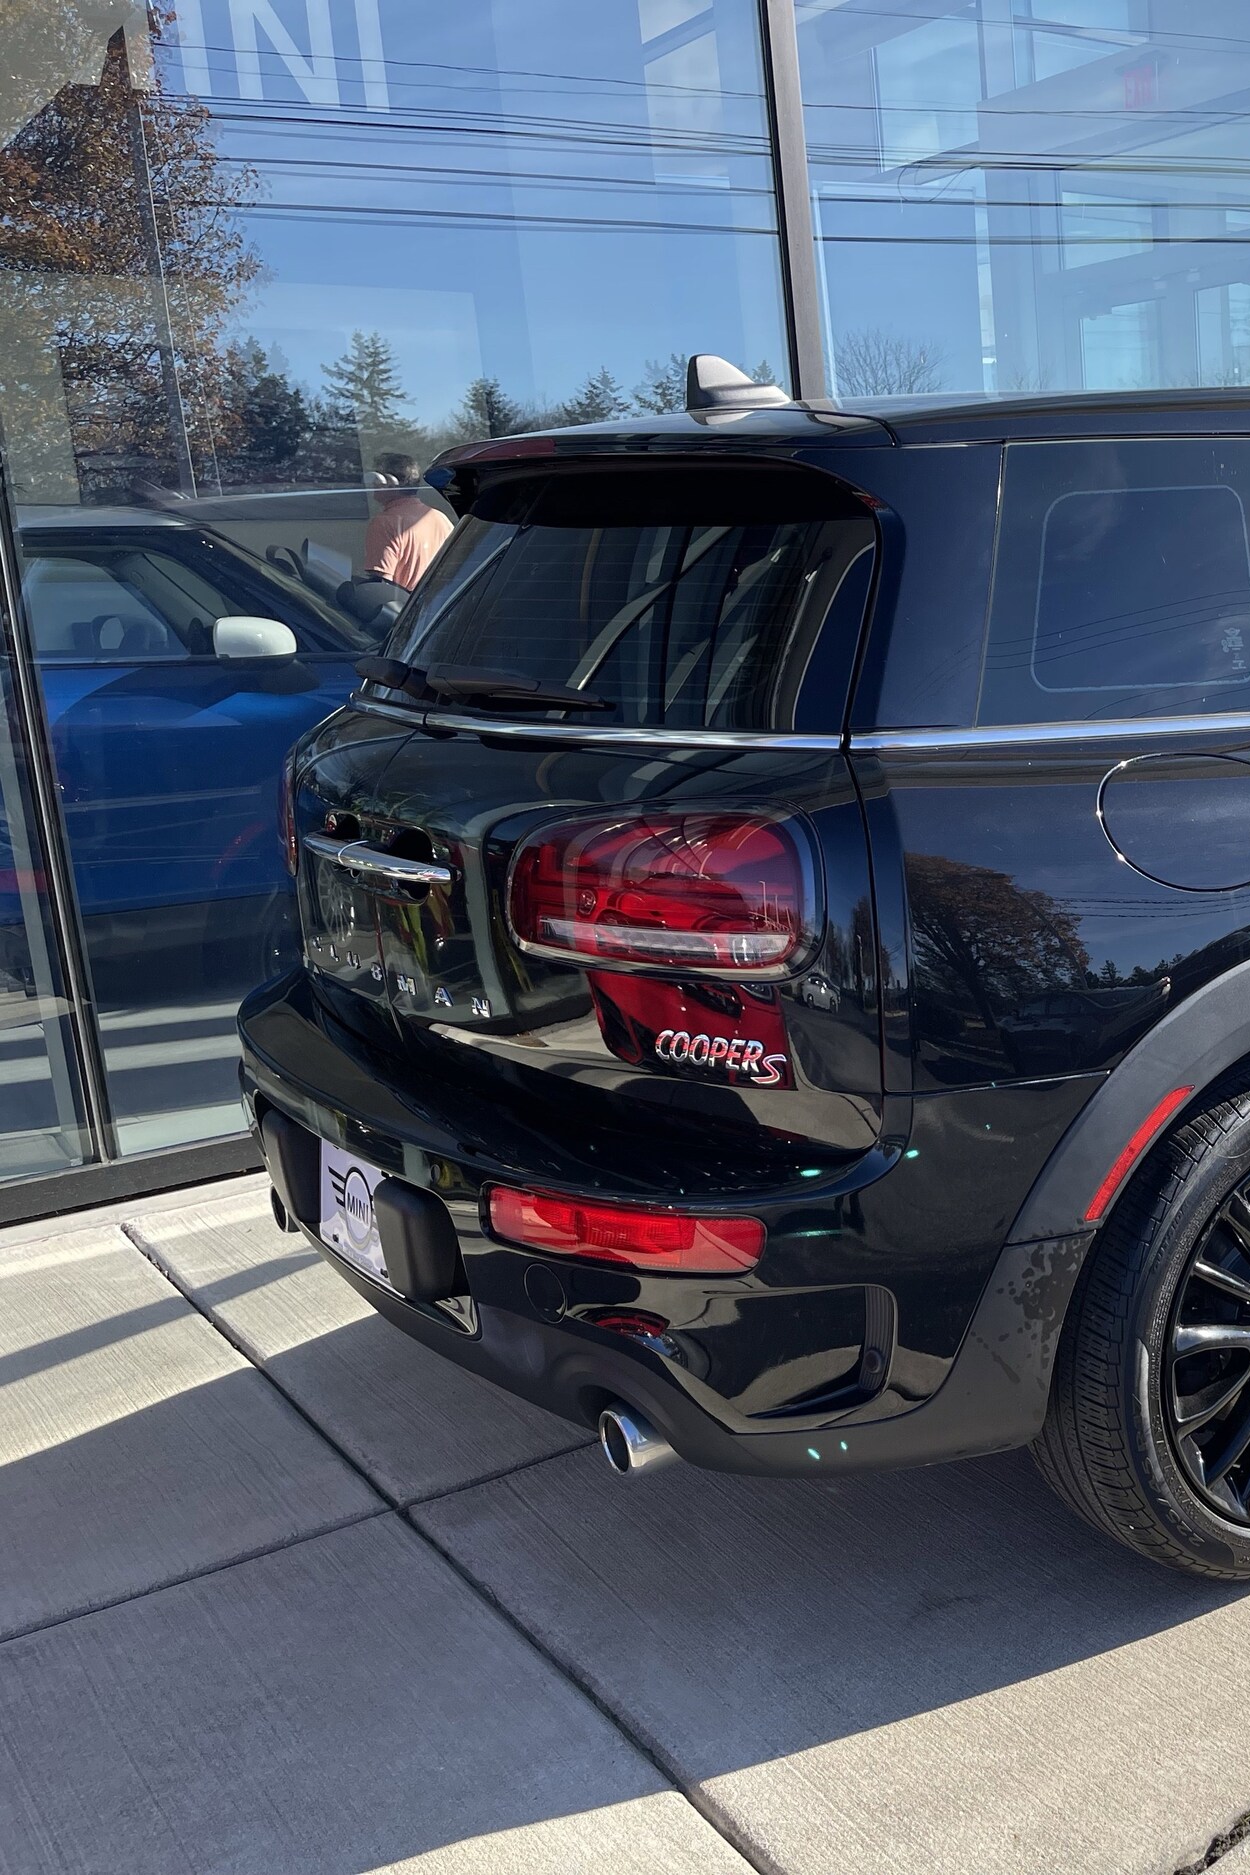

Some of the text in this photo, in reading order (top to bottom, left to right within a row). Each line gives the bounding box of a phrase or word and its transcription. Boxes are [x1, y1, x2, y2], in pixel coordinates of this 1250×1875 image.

[312, 936, 491, 1018] CLUBMAN
[655, 1029, 787, 1084] COOPER S
[346, 1191, 369, 1225] MINI
